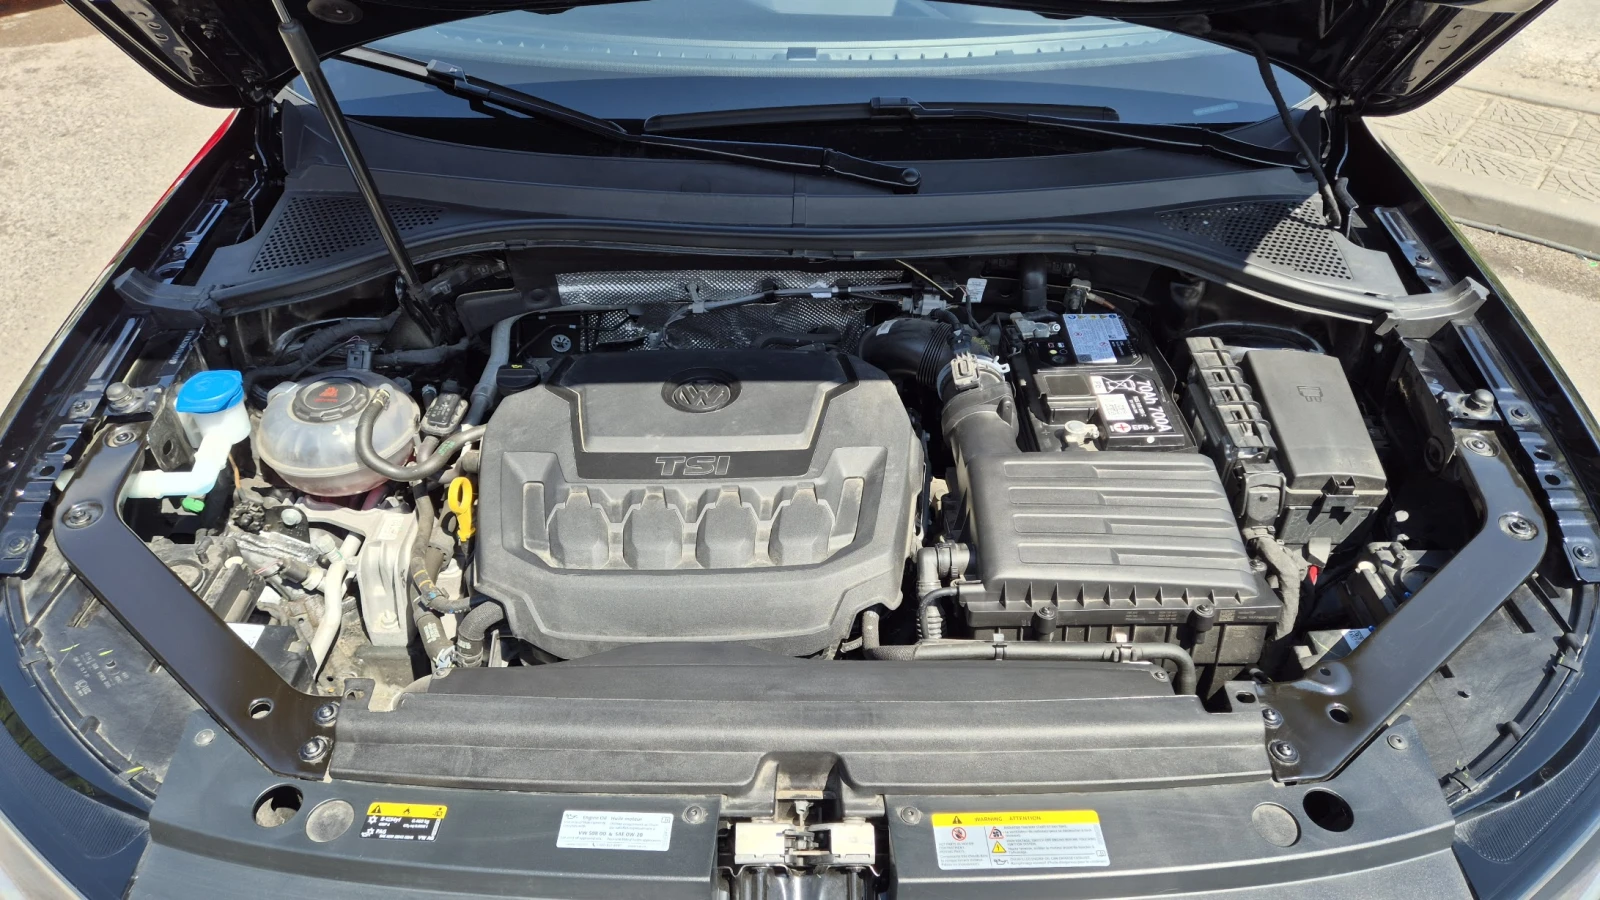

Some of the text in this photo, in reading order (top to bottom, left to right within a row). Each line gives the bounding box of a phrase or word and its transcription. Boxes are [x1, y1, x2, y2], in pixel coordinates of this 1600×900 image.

[674, 381, 729, 410] VW
[1136, 380, 1159, 405] 70Ah
[1148, 406, 1173, 432] 700A
[655, 455, 731, 476] TSI
